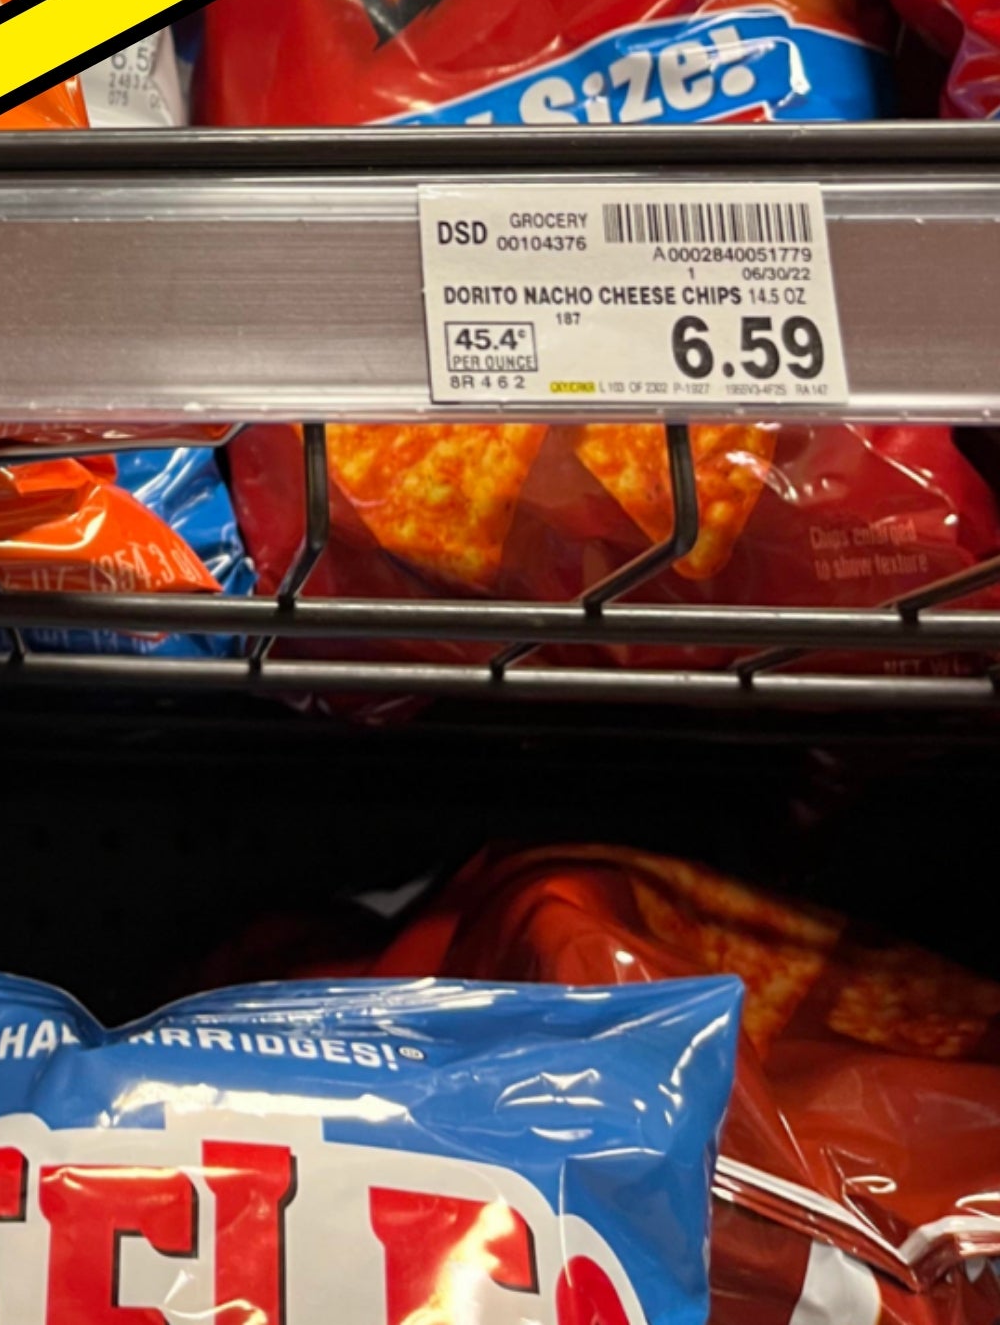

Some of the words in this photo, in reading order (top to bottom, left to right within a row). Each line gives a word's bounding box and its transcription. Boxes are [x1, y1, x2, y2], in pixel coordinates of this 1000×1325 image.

[111, 46, 150, 71] 6.5
[519, 24, 755, 125] Size!
[437, 220, 489, 245] DSD
[509, 212, 589, 229] GROCERY
[496, 236, 588, 251] 00104376
[652, 247, 813, 263] A0002840051779
[741, 266, 812, 281] 06/30/22
[443, 285, 518, 306] DORITO
[523, 285, 593, 306] NACHO
[598, 285, 677, 306] CHEESE
[681, 285, 742, 306] CHIPS
[748, 286, 780, 306] 14.5
[784, 286, 807, 306] OZ
[555, 311, 582, 326] 187
[671, 315, 825, 380] 6.59
[452, 355, 481, 372] PER
[484, 355, 534, 372] OUNCE
[481, 375, 492, 390] 4
[497, 375, 509, 390] 6
[514, 375, 526, 390] 2
